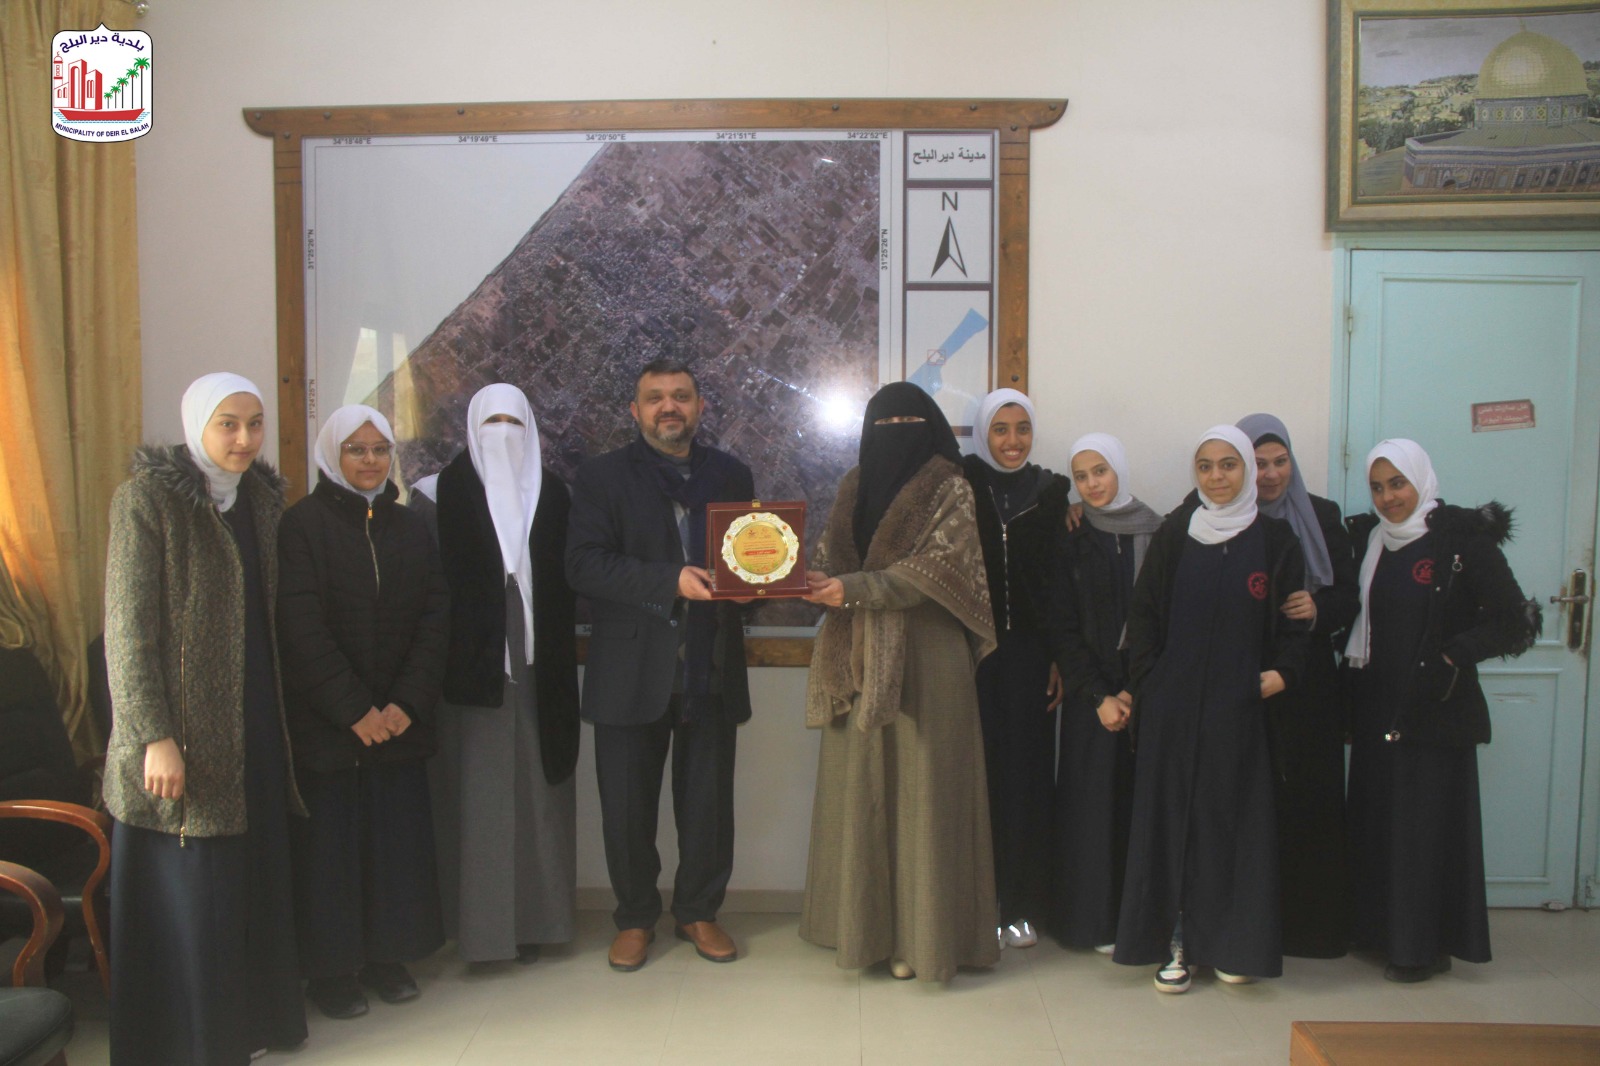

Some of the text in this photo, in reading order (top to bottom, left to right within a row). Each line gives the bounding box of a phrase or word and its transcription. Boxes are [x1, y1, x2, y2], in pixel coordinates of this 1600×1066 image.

[912, 147, 986, 165] مدينة دير البلح
[941, 191, 958, 211] N
